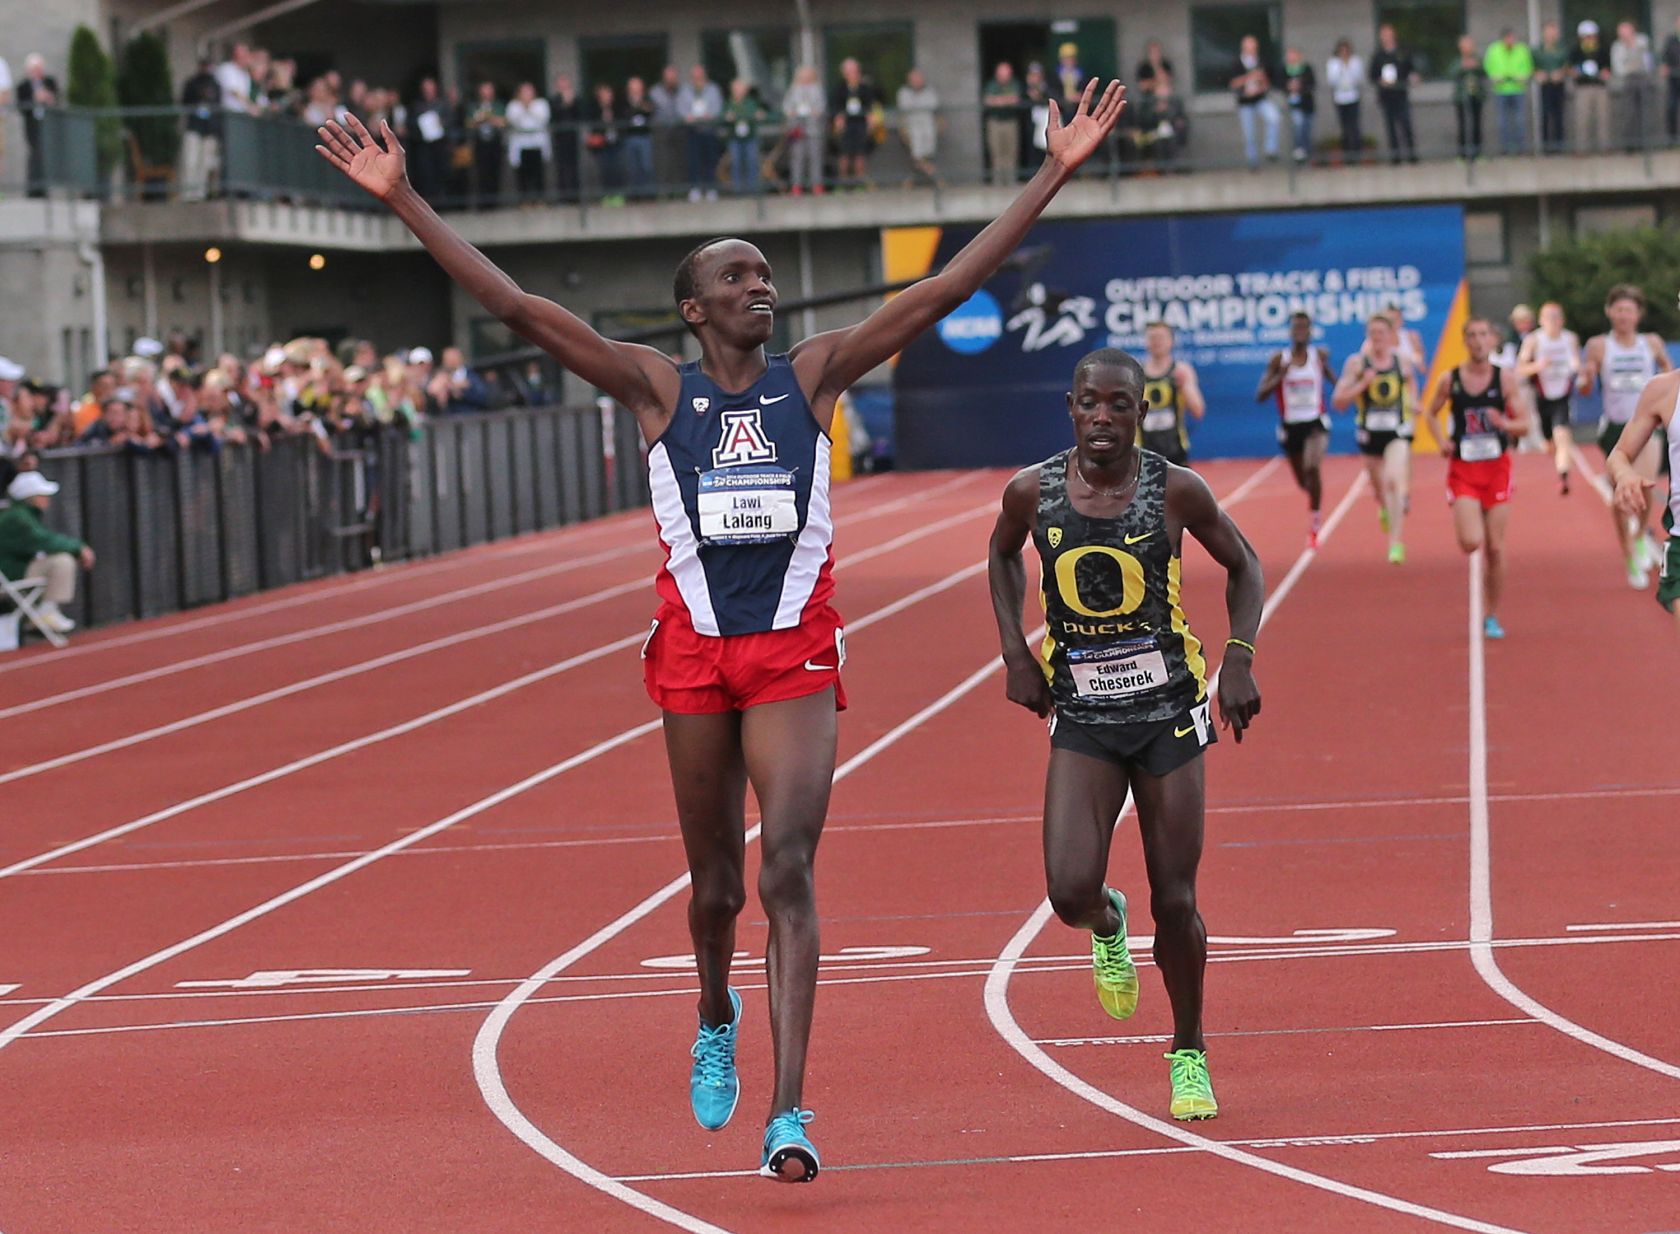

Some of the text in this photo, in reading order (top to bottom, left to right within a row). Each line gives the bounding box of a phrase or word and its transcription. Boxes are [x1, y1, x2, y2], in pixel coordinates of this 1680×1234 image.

[1105, 265, 1421, 302] OUTDOOR TRACK & FIELD
[1105, 288, 1427, 334] CHAMPIONSHIPS
[712, 409, 776, 469] A
[726, 477, 791, 486] CHAMPIONSHIPS
[733, 496, 761, 509] Lawi
[723, 513, 772, 529] Lalang
[1054, 545, 1146, 618] O
[1096, 660, 1138, 675] Edward
[1088, 670, 1154, 691] Cheserek
